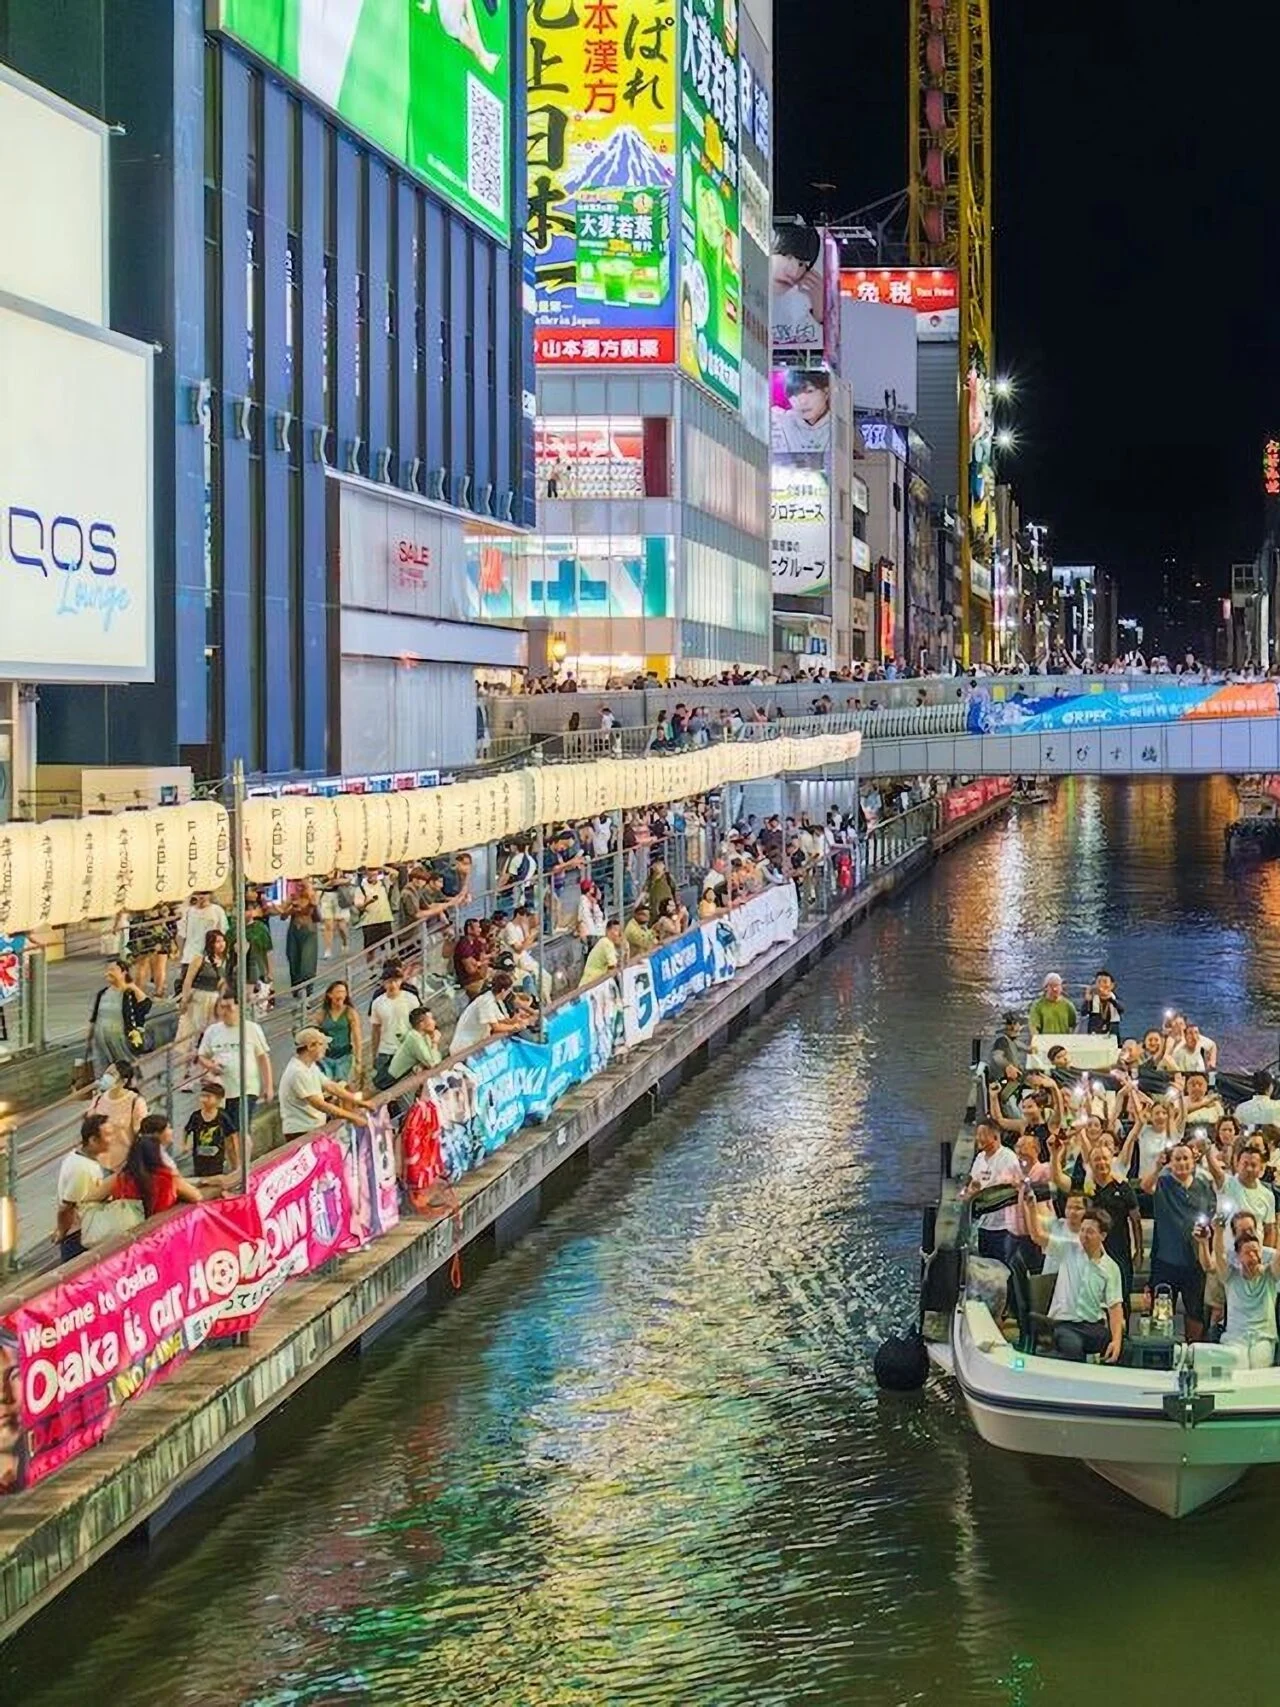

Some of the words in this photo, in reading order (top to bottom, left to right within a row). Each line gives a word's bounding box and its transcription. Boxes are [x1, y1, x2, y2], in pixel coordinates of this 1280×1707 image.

[580, 214, 653, 240] 大麦若葉
[9, 507, 118, 577] QOS
[98, 1290, 116, 1315] to
[26, 1331, 118, 1416] Osaka
[124, 1308, 148, 1355] is
